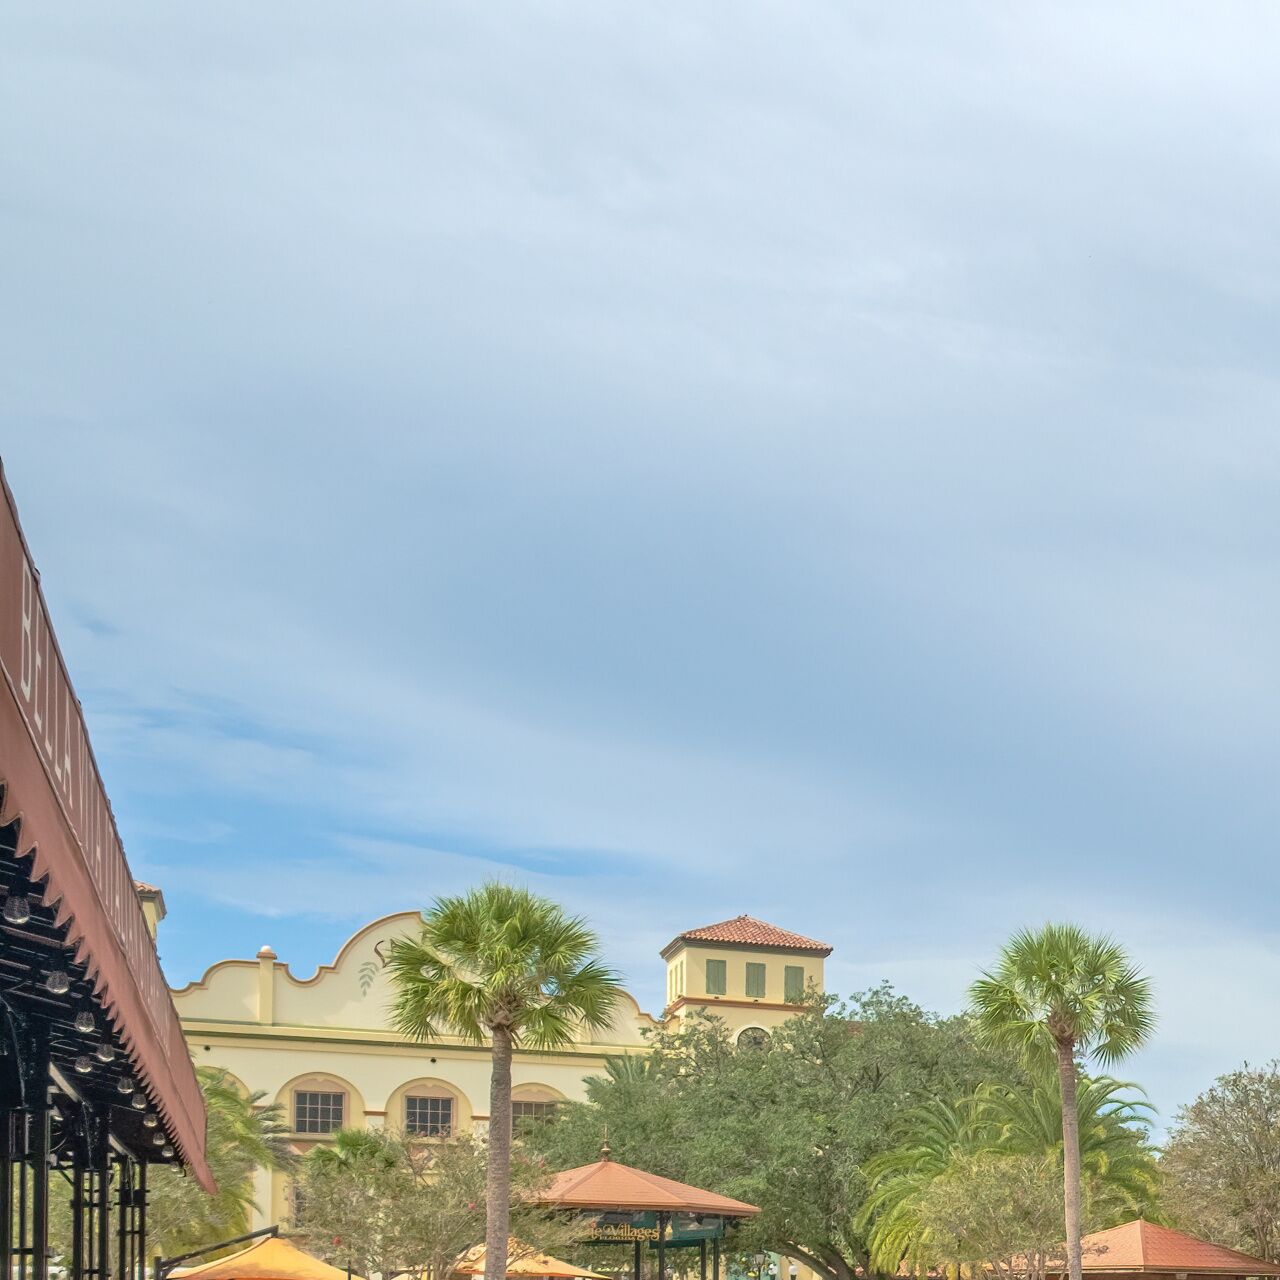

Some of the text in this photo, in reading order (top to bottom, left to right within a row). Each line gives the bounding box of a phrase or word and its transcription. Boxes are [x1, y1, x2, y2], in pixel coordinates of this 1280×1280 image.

[20, 558, 74, 810] BELLA
[77, 714, 103, 892] VITA
[603, 1223, 660, 1241] Villages
